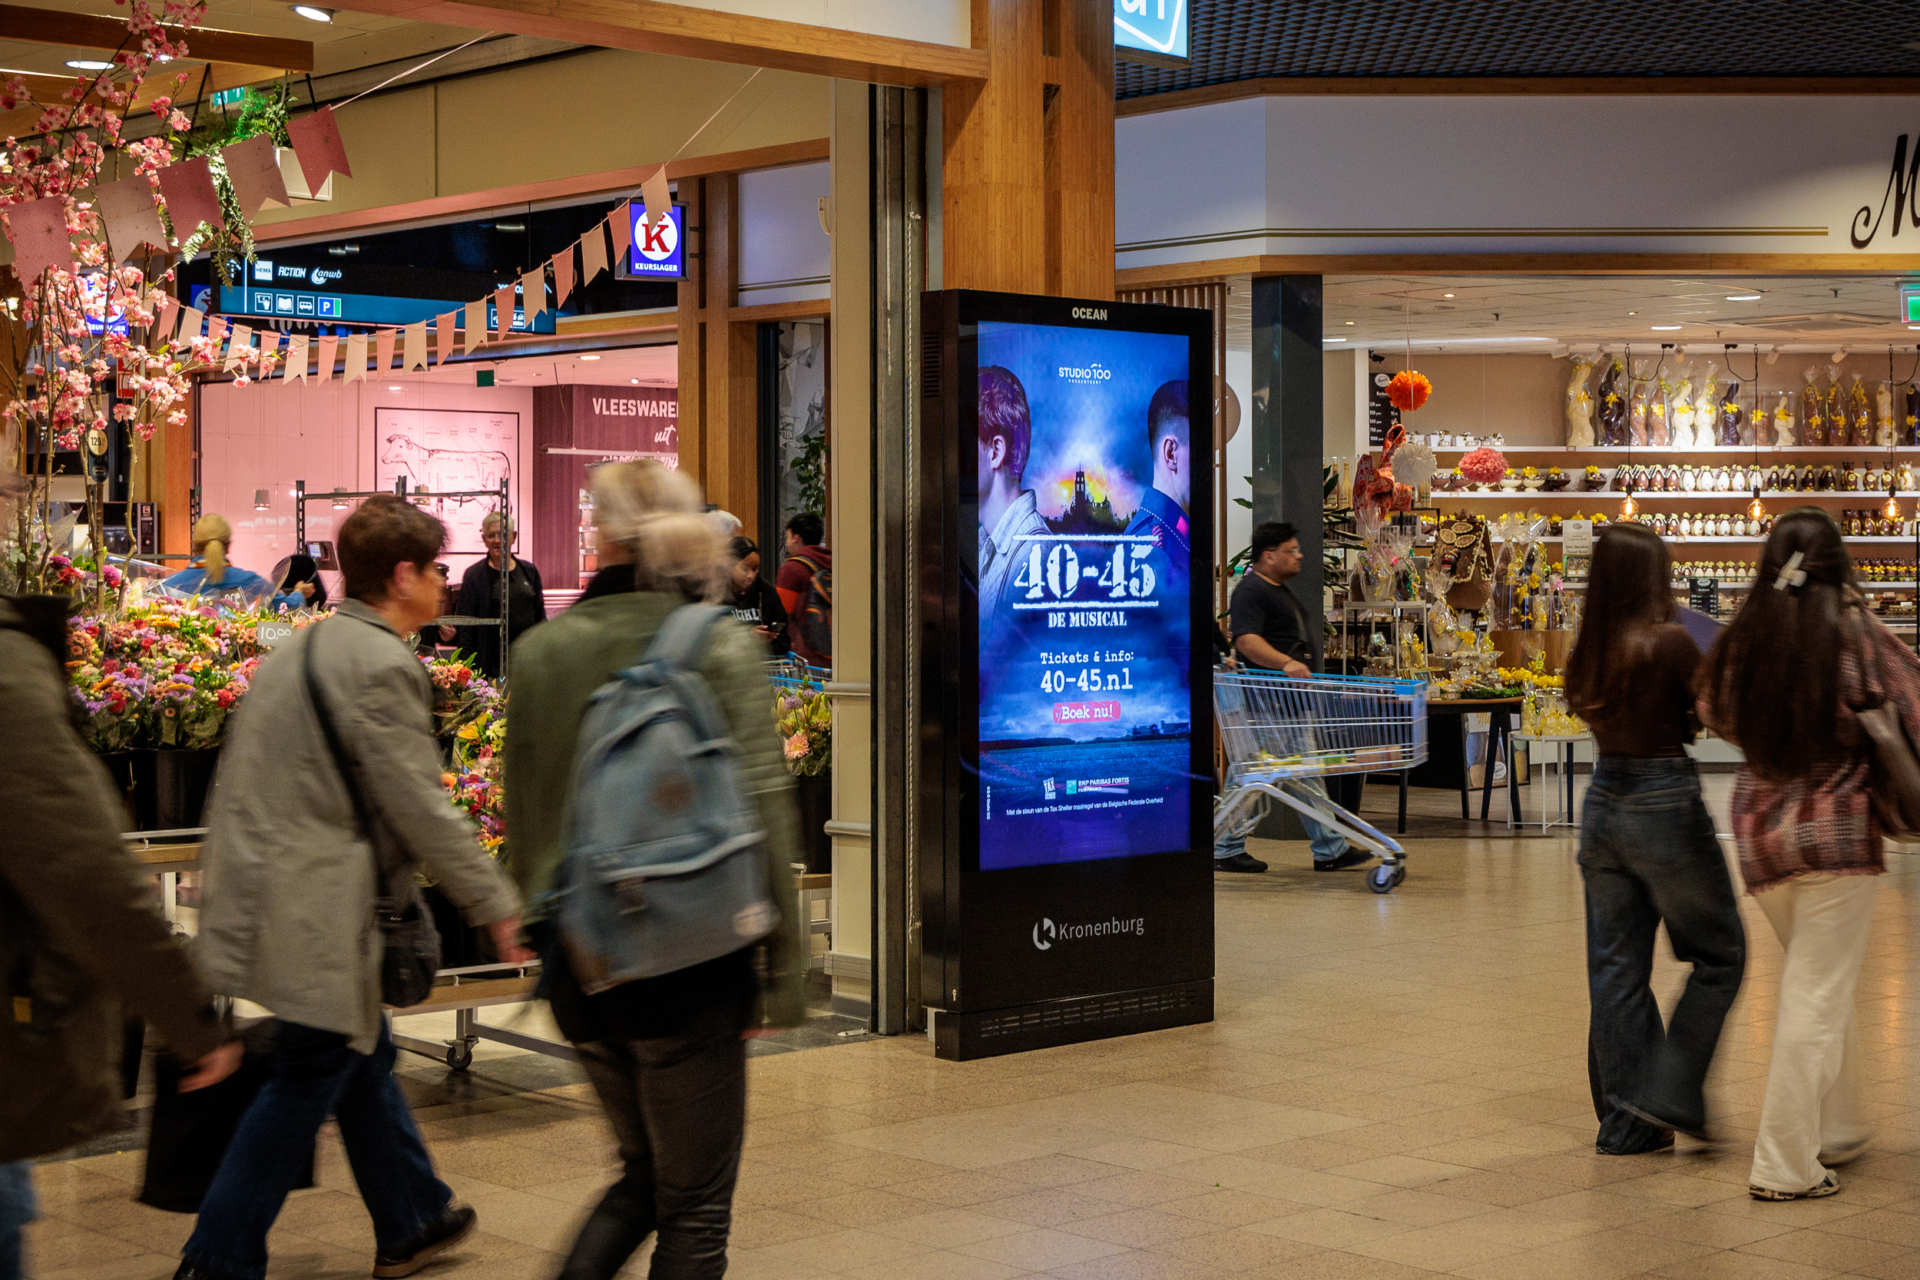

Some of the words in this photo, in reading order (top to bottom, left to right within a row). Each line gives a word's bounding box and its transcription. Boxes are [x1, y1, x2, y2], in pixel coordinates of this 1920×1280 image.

[642, 223, 670, 253] K
[278, 266, 307, 278] ACTION
[317, 269, 342, 279] anwb
[635, 262, 678, 272] KEURSLAGER
[1072, 306, 1108, 321] OCEAN
[1058, 366, 1092, 379] STUDIO
[1093, 369, 1111, 380] 100
[592, 397, 679, 418] VLEESWARE
[654, 424, 676, 445] uit
[1013, 543, 1156, 599] 40-45
[1048, 612, 1066, 628] DE
[1069, 611, 1127, 628] MUSICAL
[1040, 651, 1089, 665] Tickets
[1093, 651, 1100, 663] &
[1104, 649, 1134, 662] info:
[1040, 667, 1134, 693] 40-45.nl
[1061, 704, 1091, 720] Boek
[1094, 703, 1113, 718] nu!
[1043, 780, 1056, 793] TAX
[1089, 777, 1111, 785] PARIBAS
[1059, 916, 1144, 940] Kronenburg
